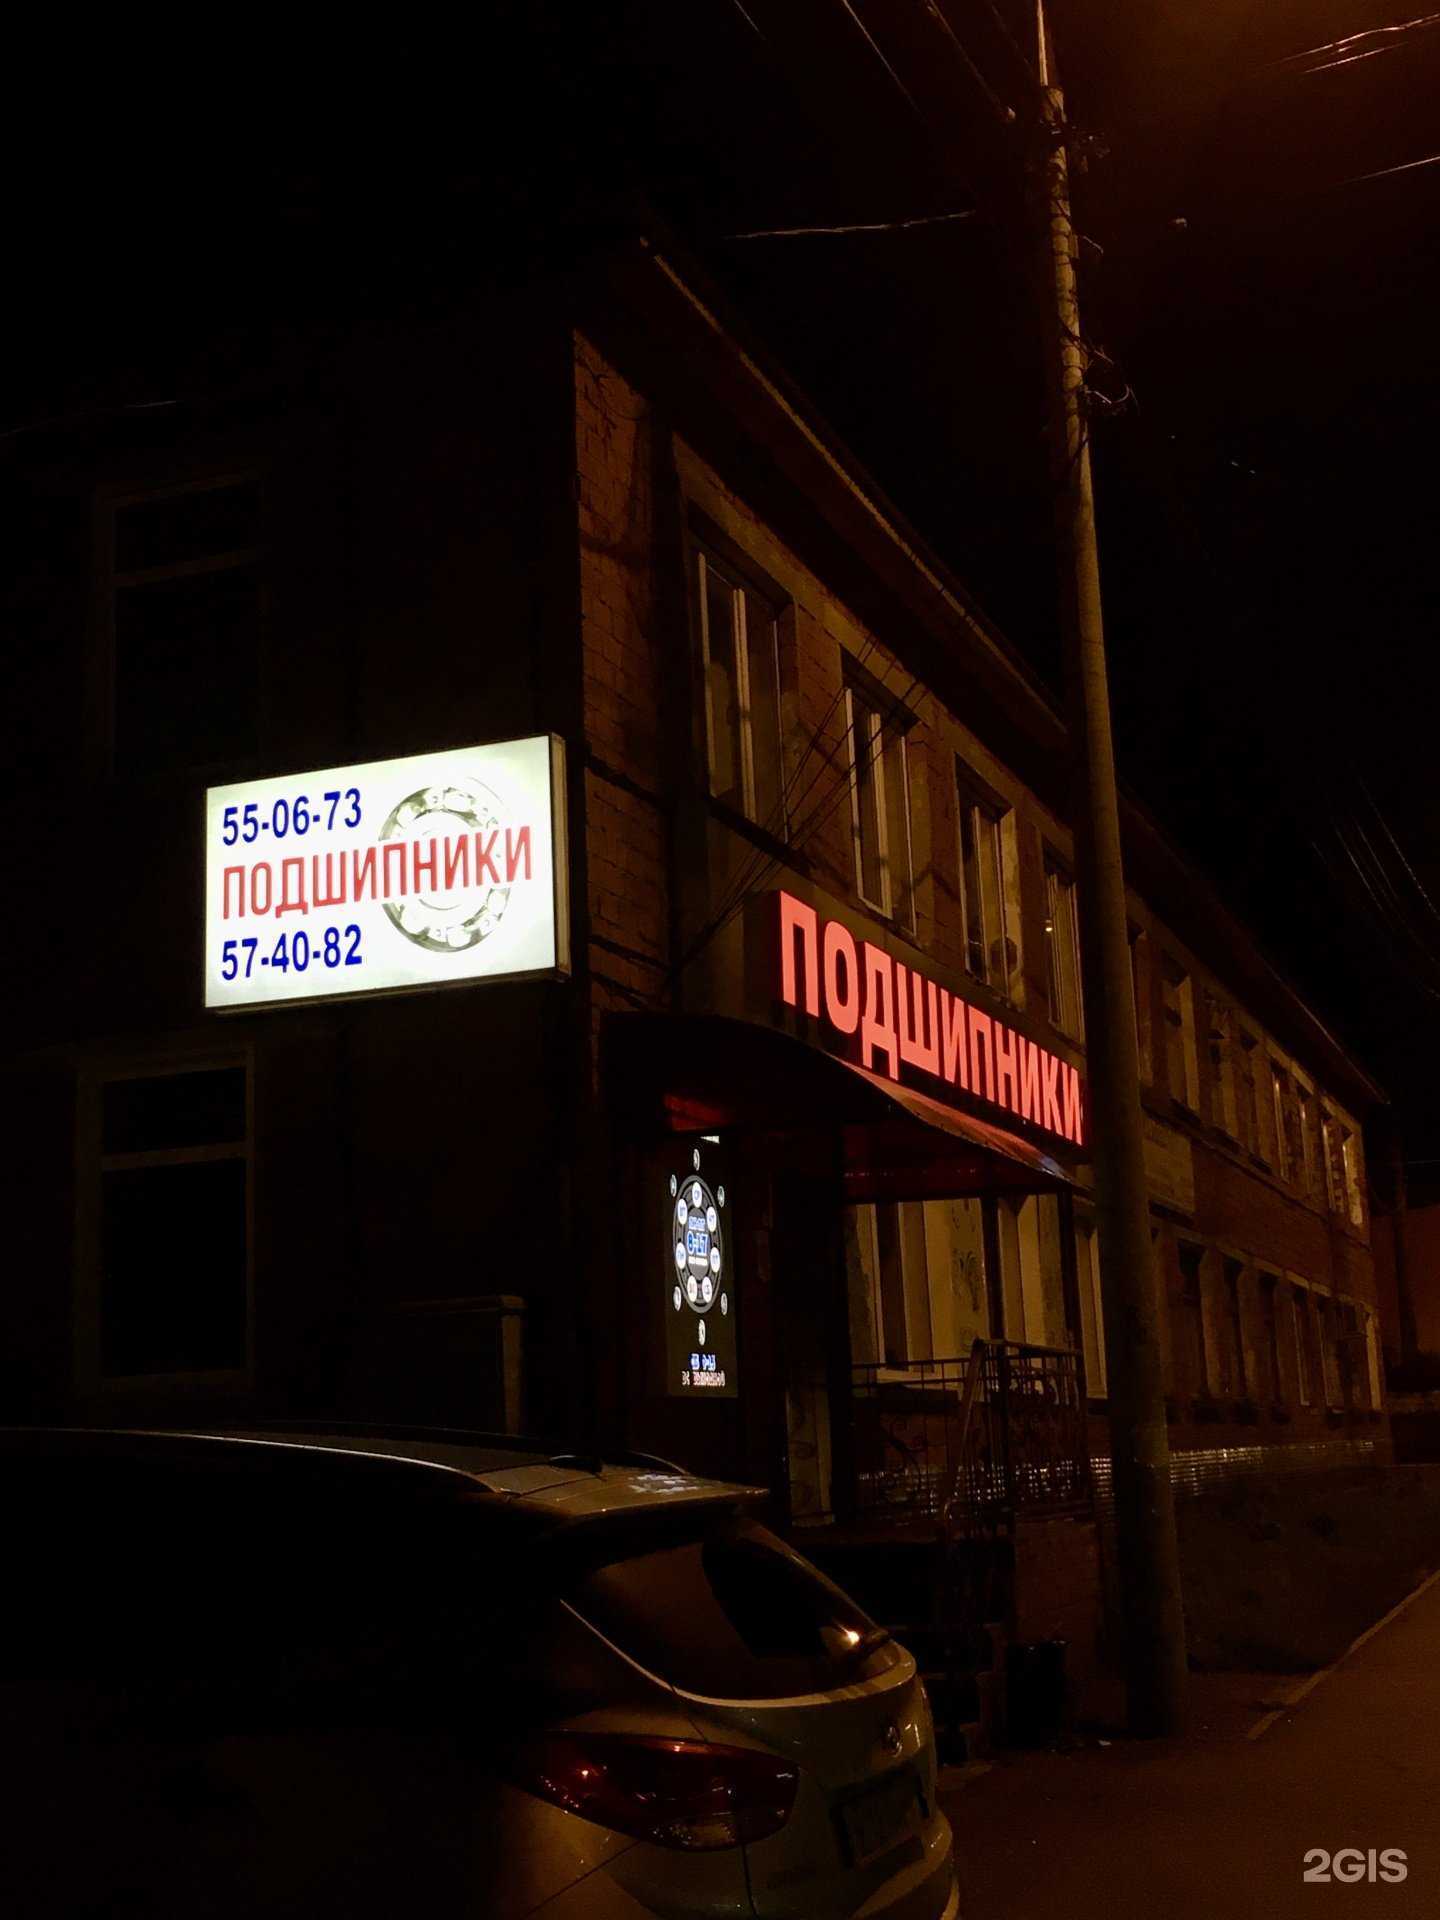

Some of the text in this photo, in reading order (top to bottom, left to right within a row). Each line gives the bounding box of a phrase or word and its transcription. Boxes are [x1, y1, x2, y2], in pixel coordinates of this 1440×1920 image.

[222, 786, 362, 846] 55-06-73
[222, 825, 532, 921] ПОДШИПНИКИ
[222, 922, 363, 980] 57-40-82
[779, 890, 1084, 1147] ПОДШИПНИКИ
